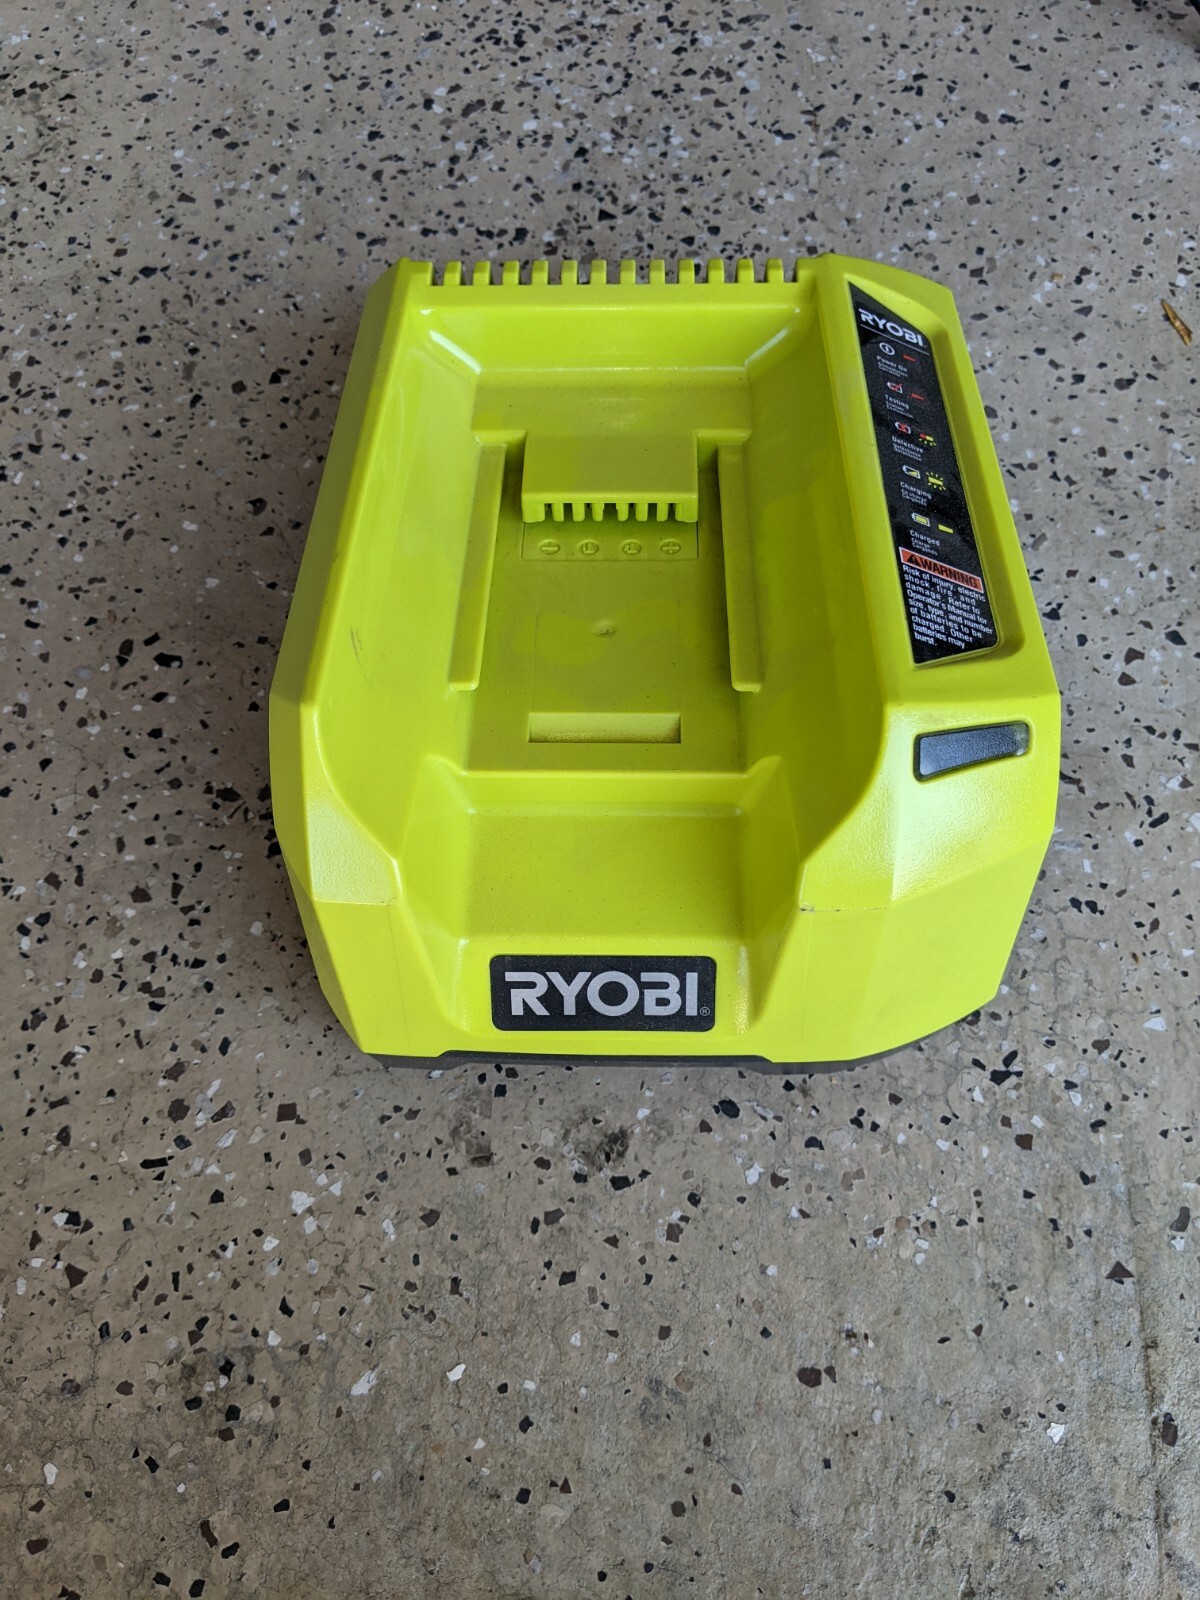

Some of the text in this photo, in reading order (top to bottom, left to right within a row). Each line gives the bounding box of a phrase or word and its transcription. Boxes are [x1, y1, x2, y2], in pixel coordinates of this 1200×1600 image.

[858, 308, 924, 347] RYOBI
[892, 435, 923, 453] Defective
[900, 481, 932, 500] Charging
[910, 529, 940, 547] Charged
[903, 564, 920, 577] Risk
[957, 586, 986, 602] electric
[920, 557, 978, 588] WARNING
[948, 597, 970, 611] Refer
[972, 605, 980, 614] to
[960, 595, 976, 606] and
[910, 606, 982, 638] of batteries to be
[947, 604, 975, 620] Manual
[977, 615, 987, 625] for
[948, 613, 962, 623] and
[964, 619, 993, 635] number
[913, 623, 965, 650] batteries may
[950, 628, 973, 643] Other
[504, 970, 699, 1017] RYOBI
